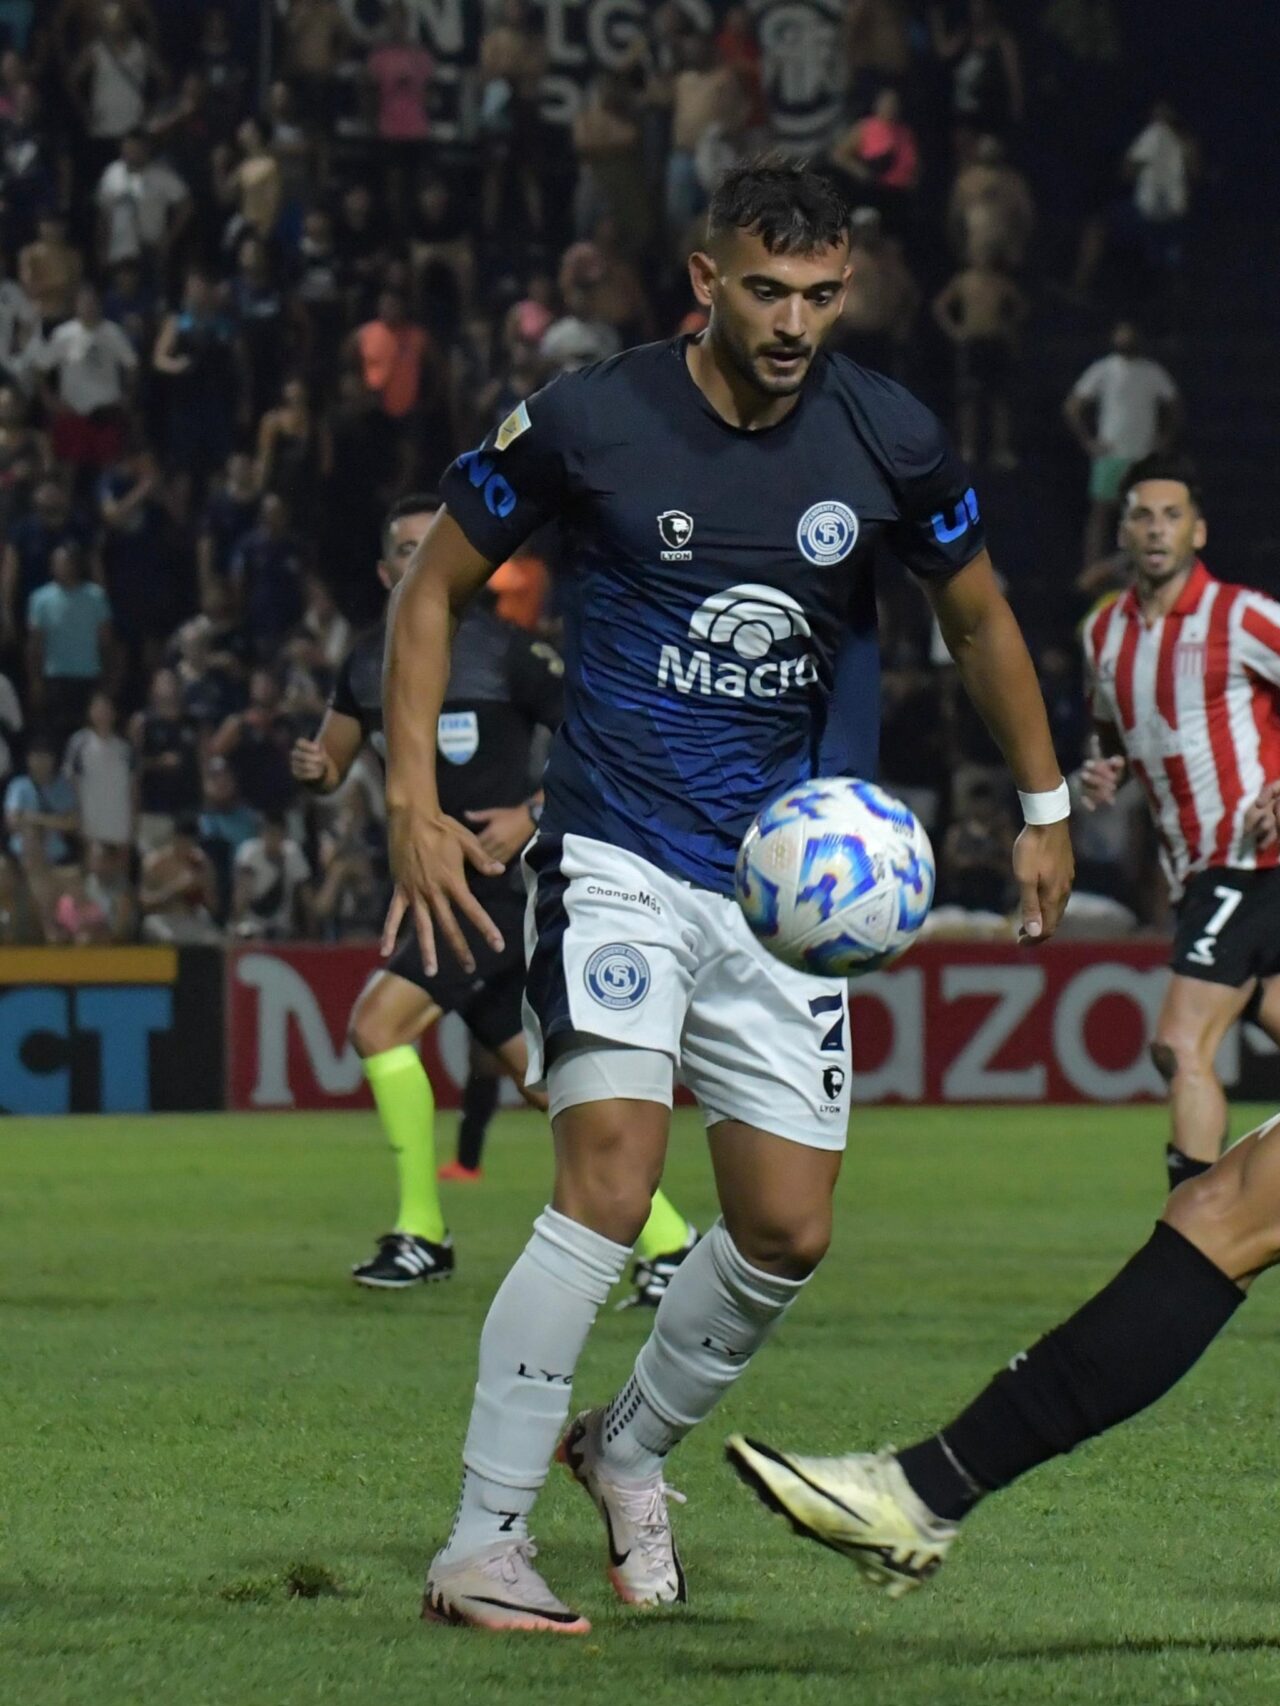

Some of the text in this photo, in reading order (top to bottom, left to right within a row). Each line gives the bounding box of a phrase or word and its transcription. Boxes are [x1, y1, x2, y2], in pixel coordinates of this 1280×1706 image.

[661, 551, 692, 560] LYON
[656, 643, 820, 699] Macro
[1204, 885, 1243, 936] 7
[808, 990, 845, 1051] 7
[819, 1104, 841, 1114] LYON
